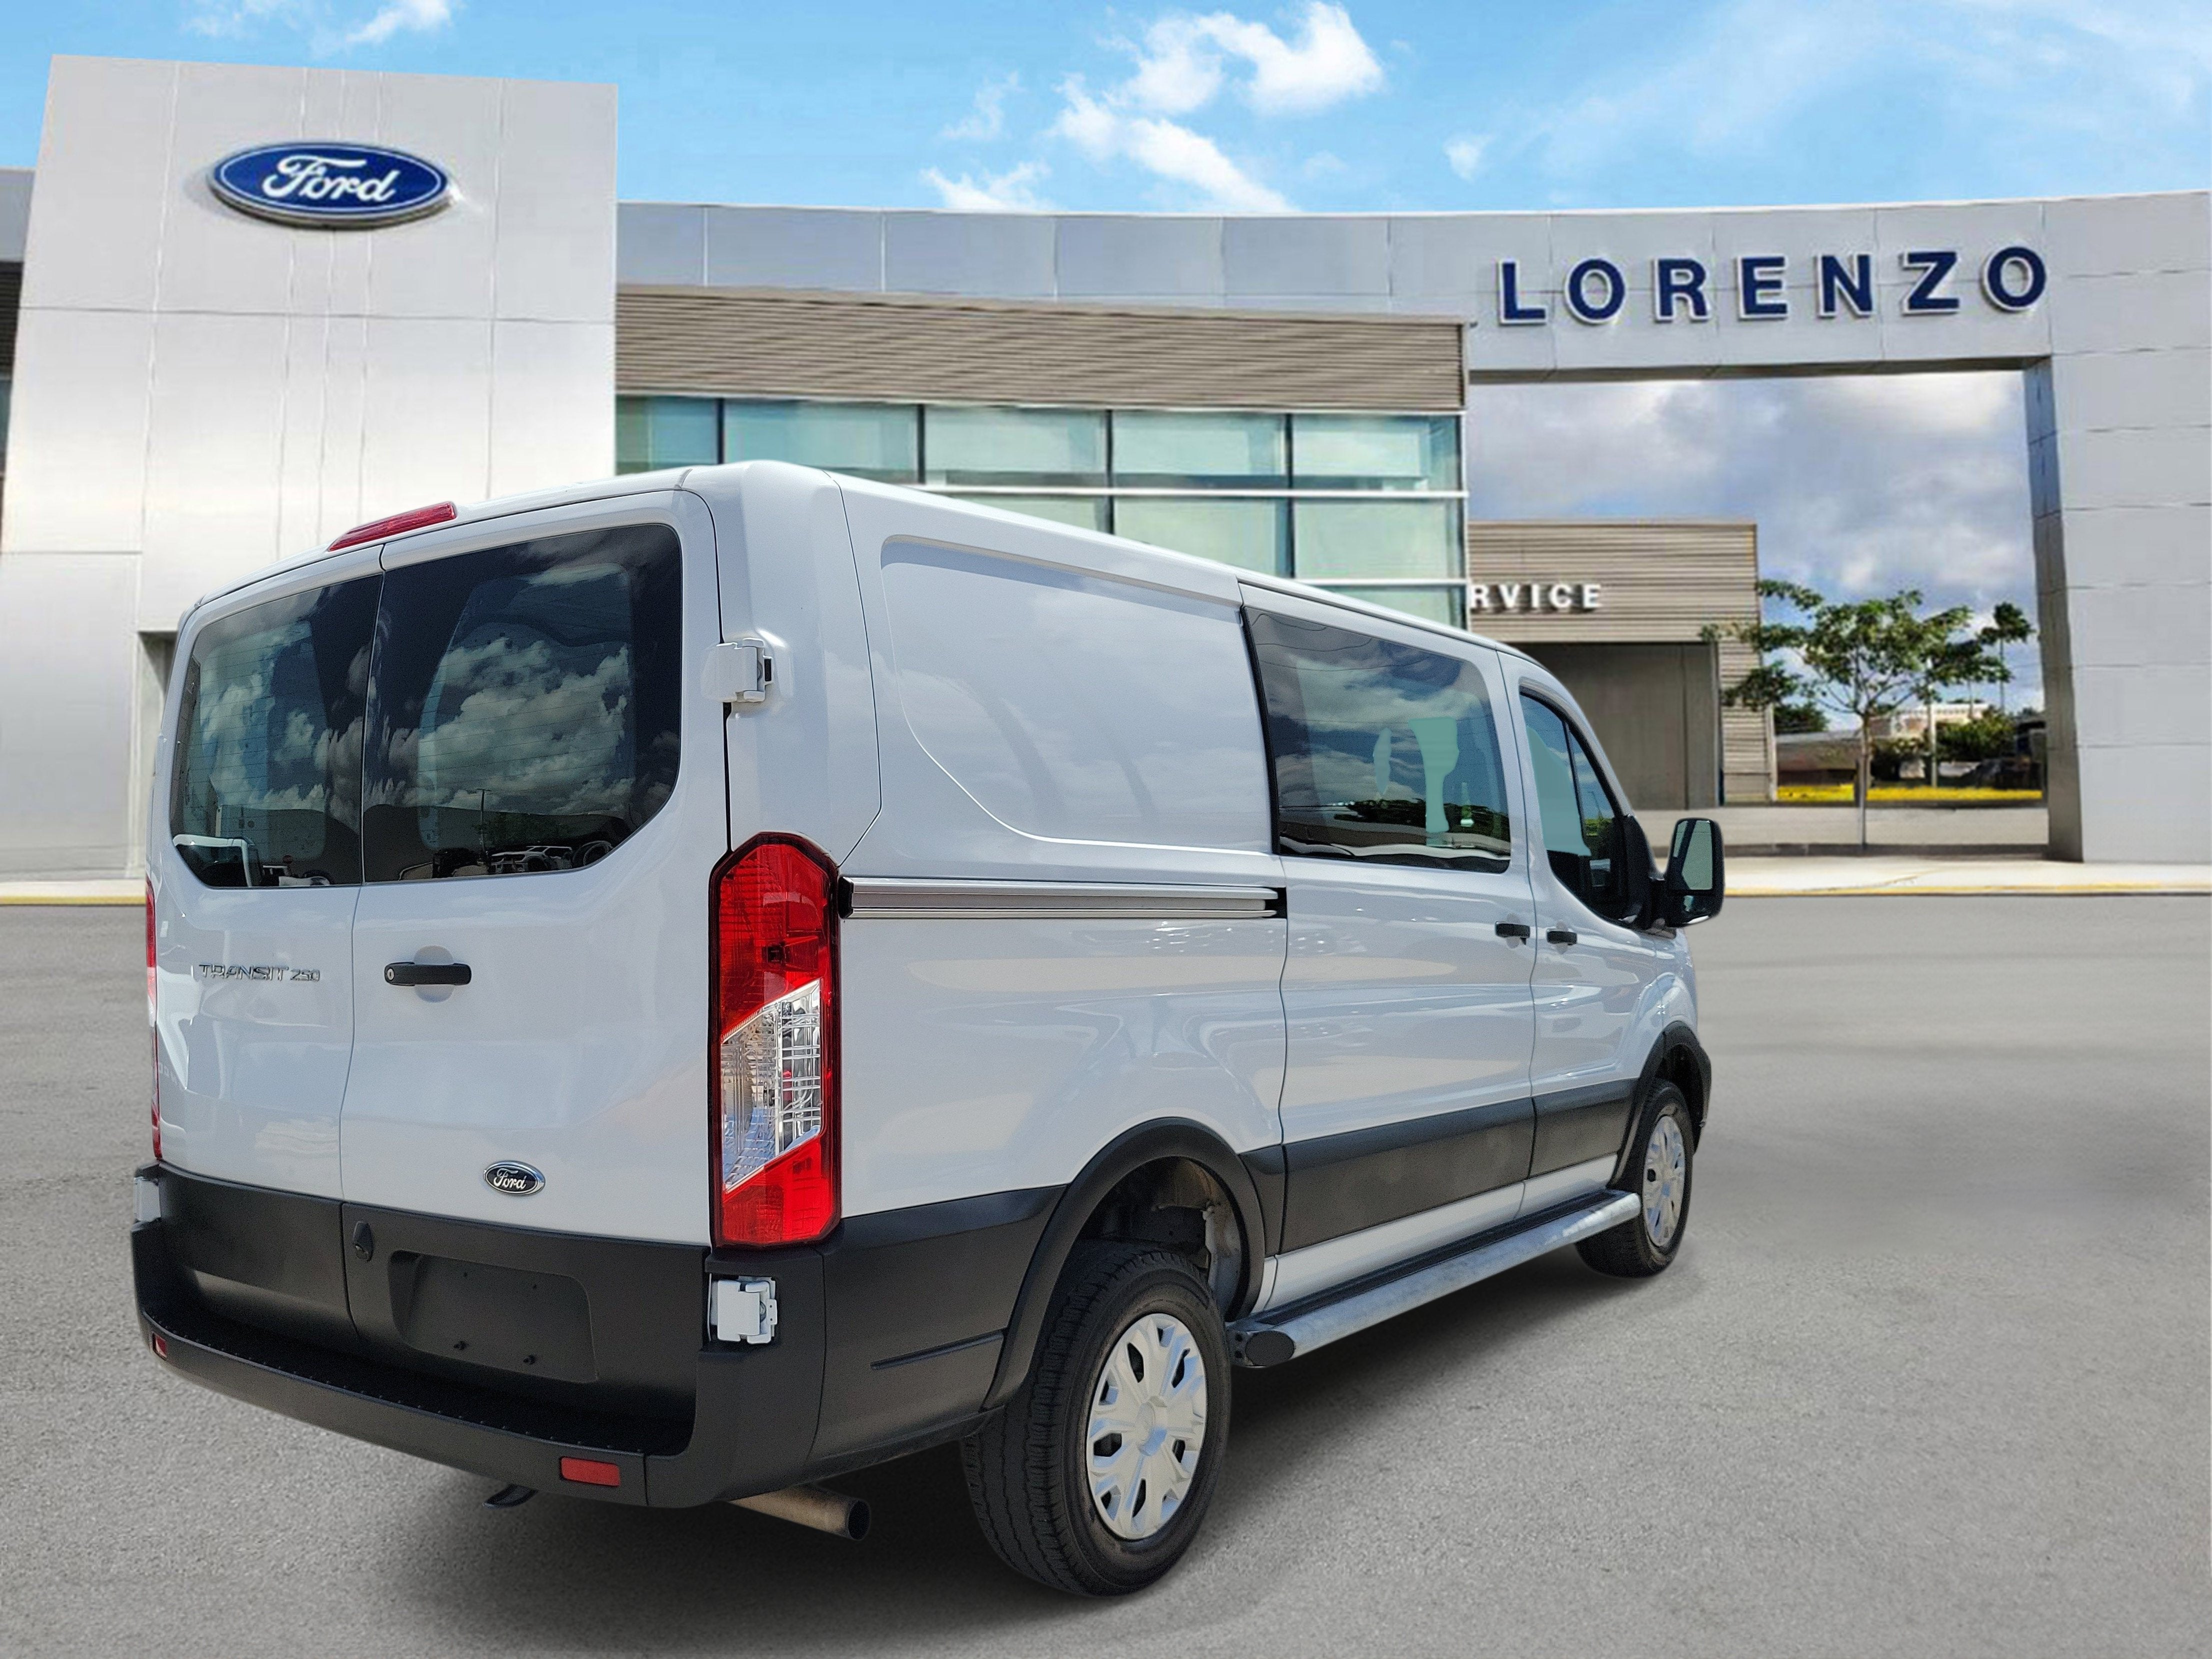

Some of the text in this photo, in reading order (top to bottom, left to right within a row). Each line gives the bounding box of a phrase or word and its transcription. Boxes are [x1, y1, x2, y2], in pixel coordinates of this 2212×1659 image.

[262, 154, 400, 202] Ford
[1498, 246, 2046, 326] LORENZO
[1470, 584, 1602, 608] RVICE
[198, 964, 320, 982] TRANSIT 250
[494, 1168, 528, 1190] Ford
